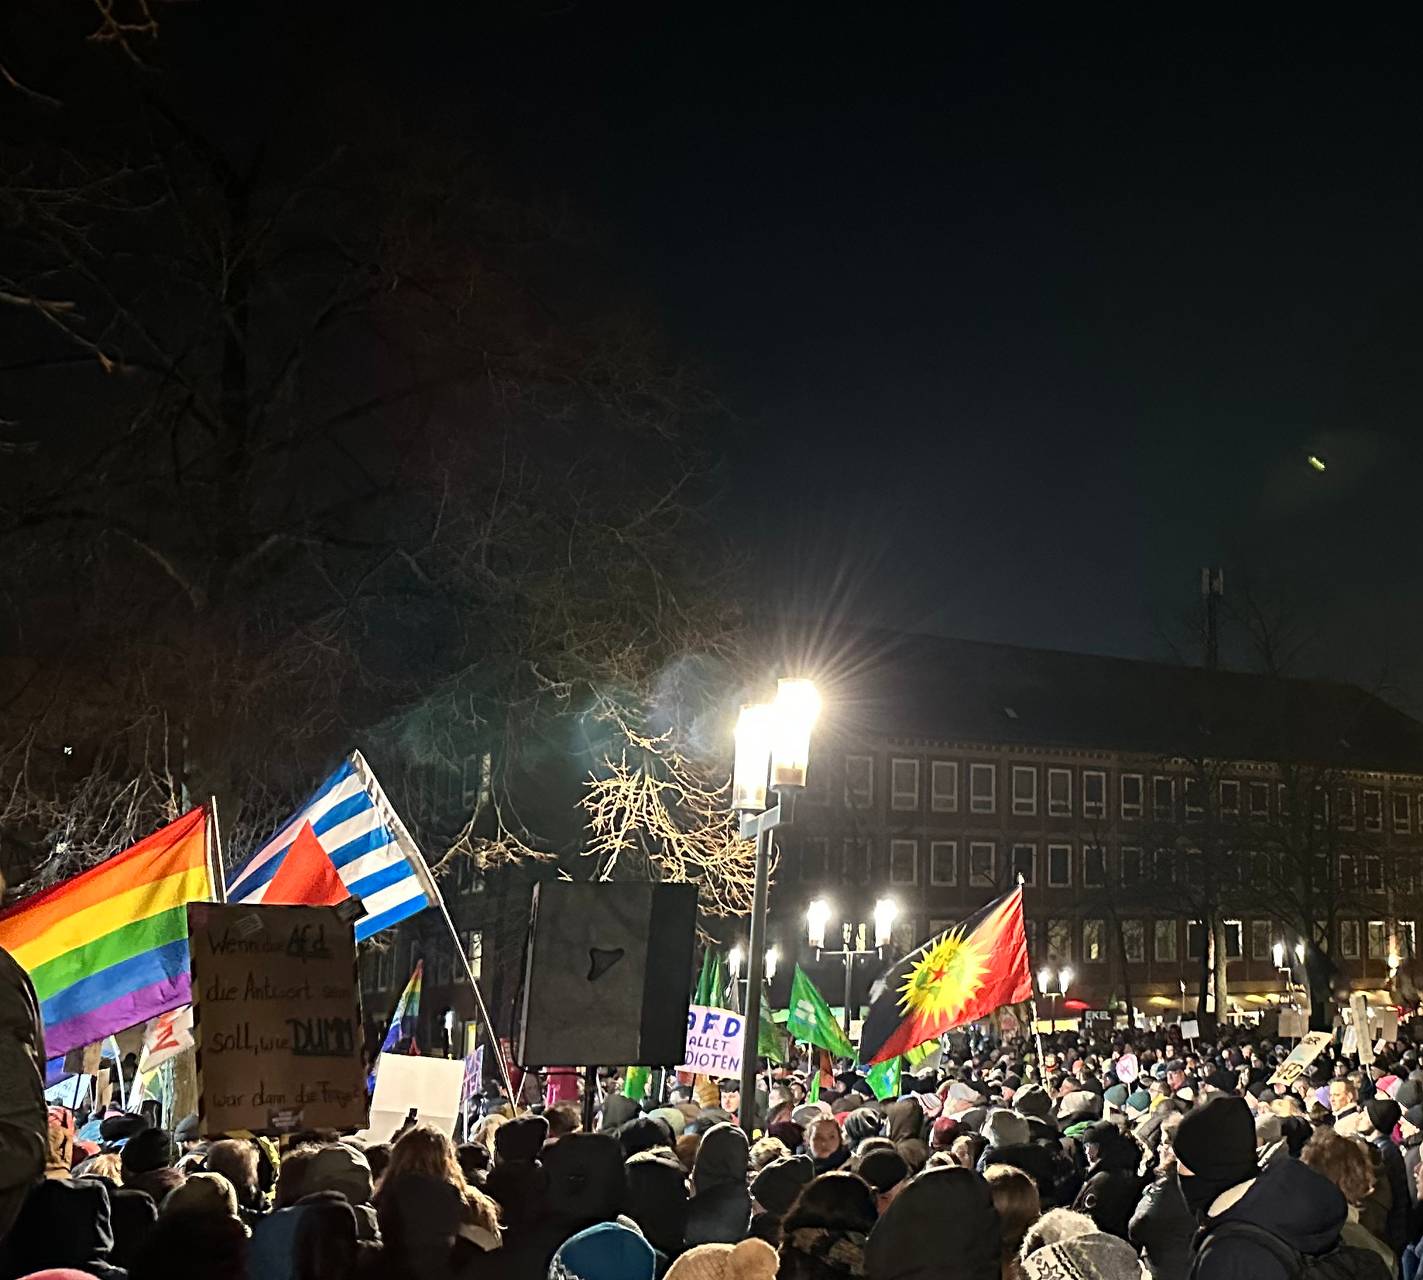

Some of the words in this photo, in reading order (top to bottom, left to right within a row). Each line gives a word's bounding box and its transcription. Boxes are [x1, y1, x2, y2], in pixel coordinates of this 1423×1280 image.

[208, 926, 256, 955] Wenn
[207, 972, 239, 1001] die
[243, 968, 314, 1001] Antwort
[287, 1017, 354, 1057] DUMM
[212, 1092, 244, 1107] war
[252, 1080, 286, 1107] dann
